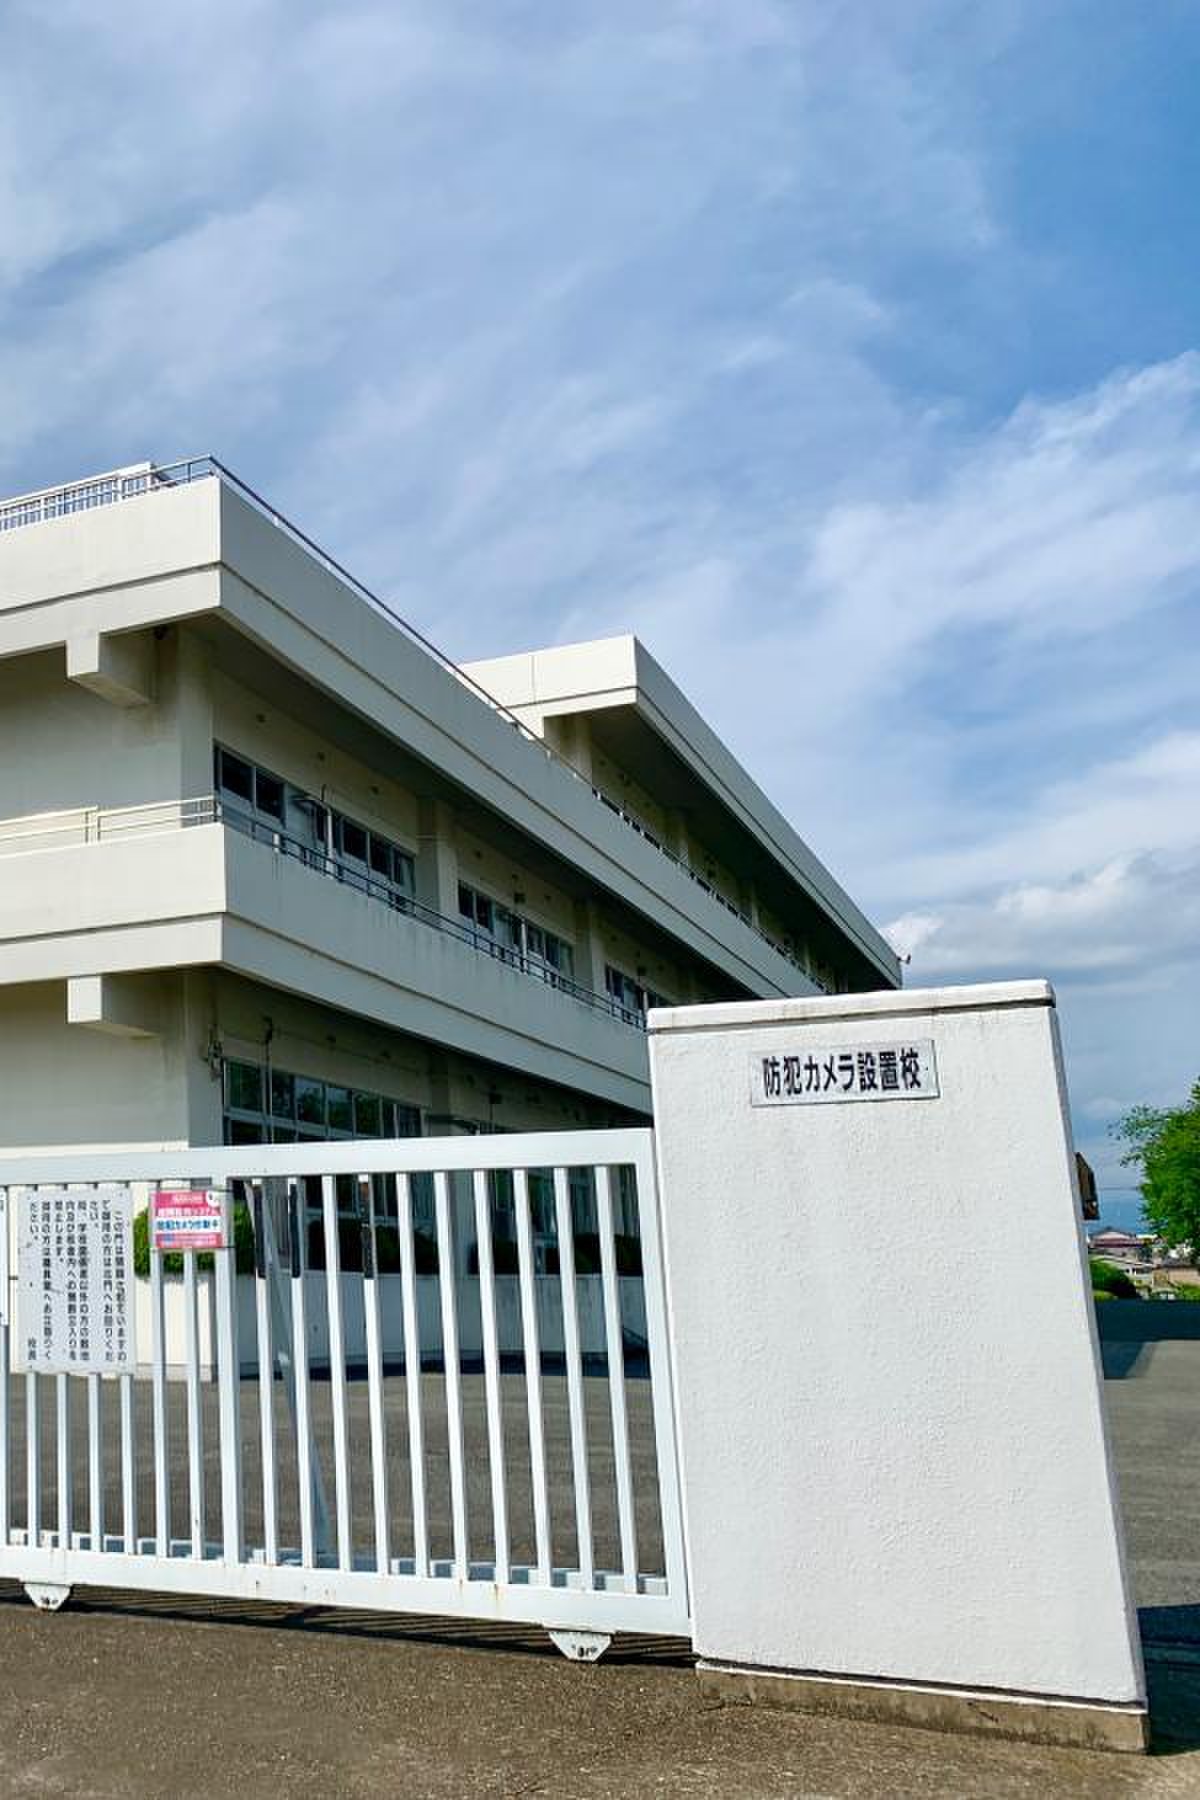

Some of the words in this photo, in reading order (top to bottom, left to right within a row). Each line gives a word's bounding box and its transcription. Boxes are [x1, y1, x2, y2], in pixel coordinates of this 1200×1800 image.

[763, 1048, 921, 1097] 防犯カメラ設置校
